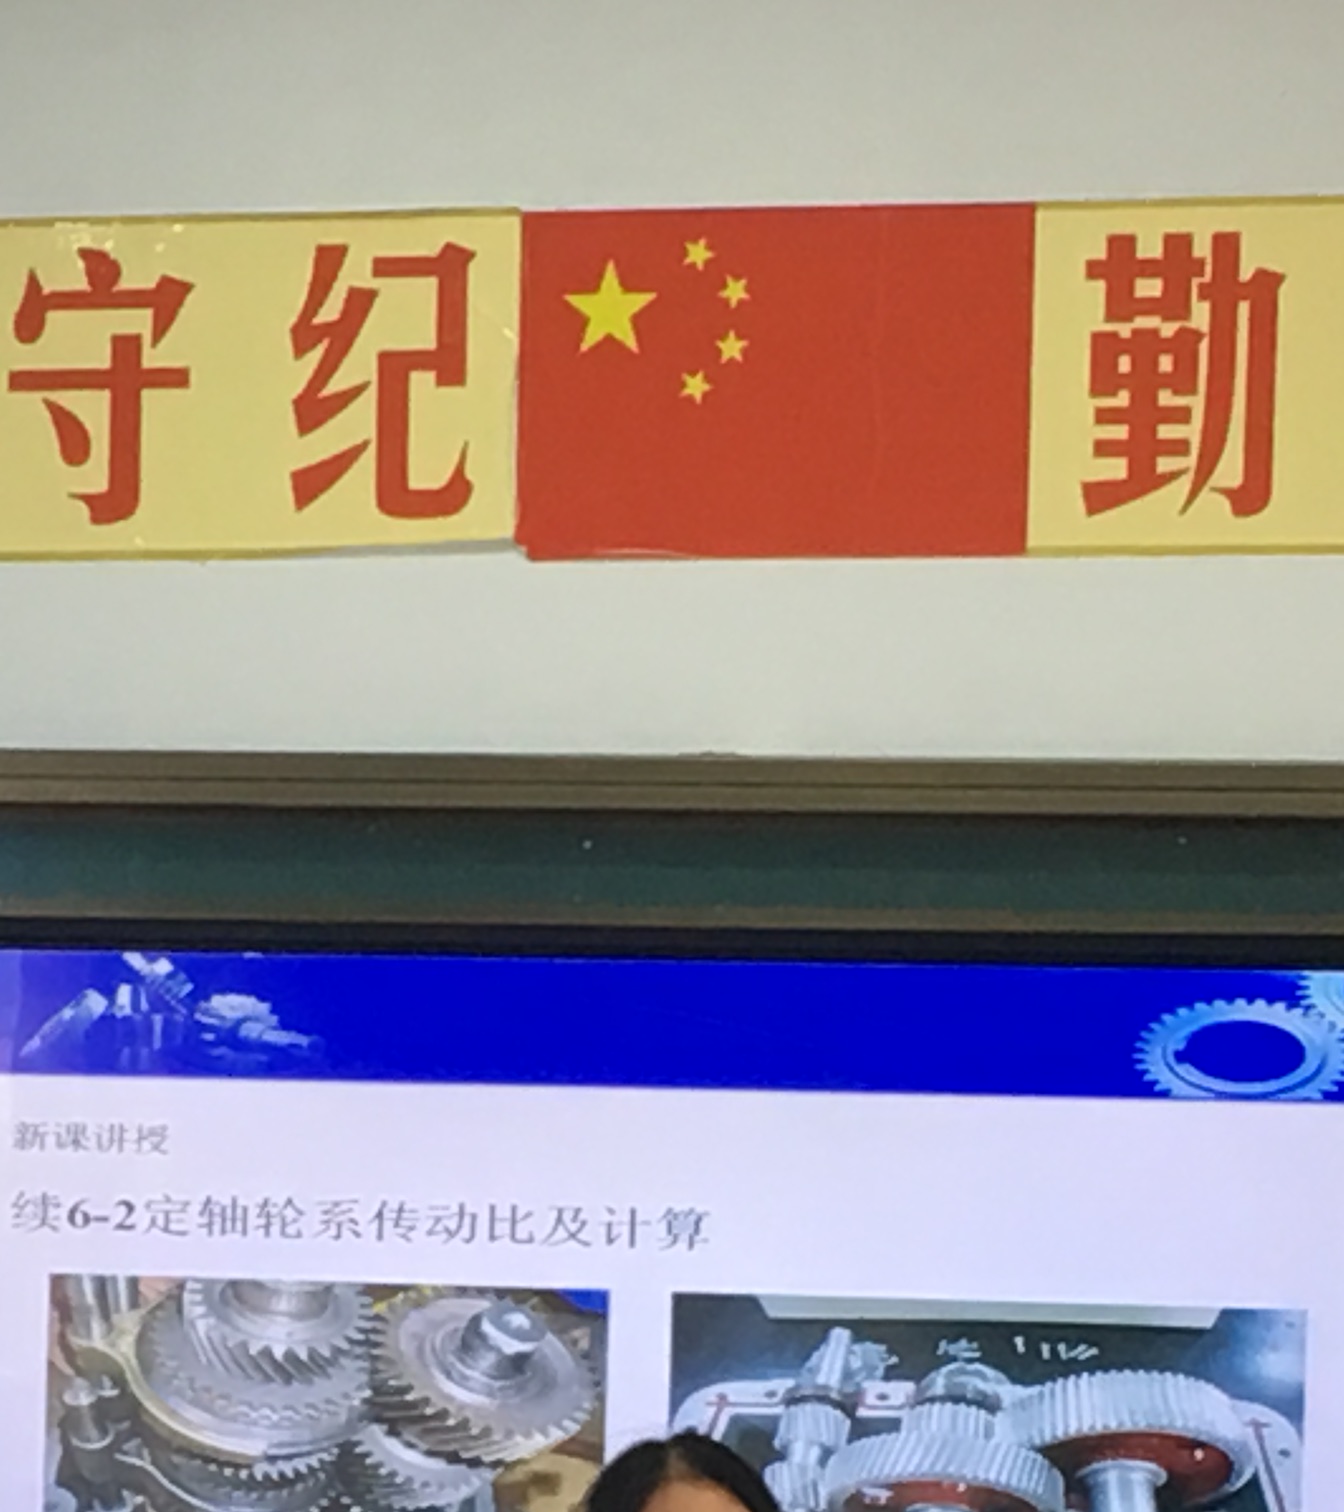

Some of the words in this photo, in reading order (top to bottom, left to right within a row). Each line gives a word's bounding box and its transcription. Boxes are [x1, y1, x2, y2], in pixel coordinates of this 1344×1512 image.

[11, 1121, 170, 1155] 新课讲授
[11, 1191, 711, 1251] 续6-2定轴轮系传动比及计算
